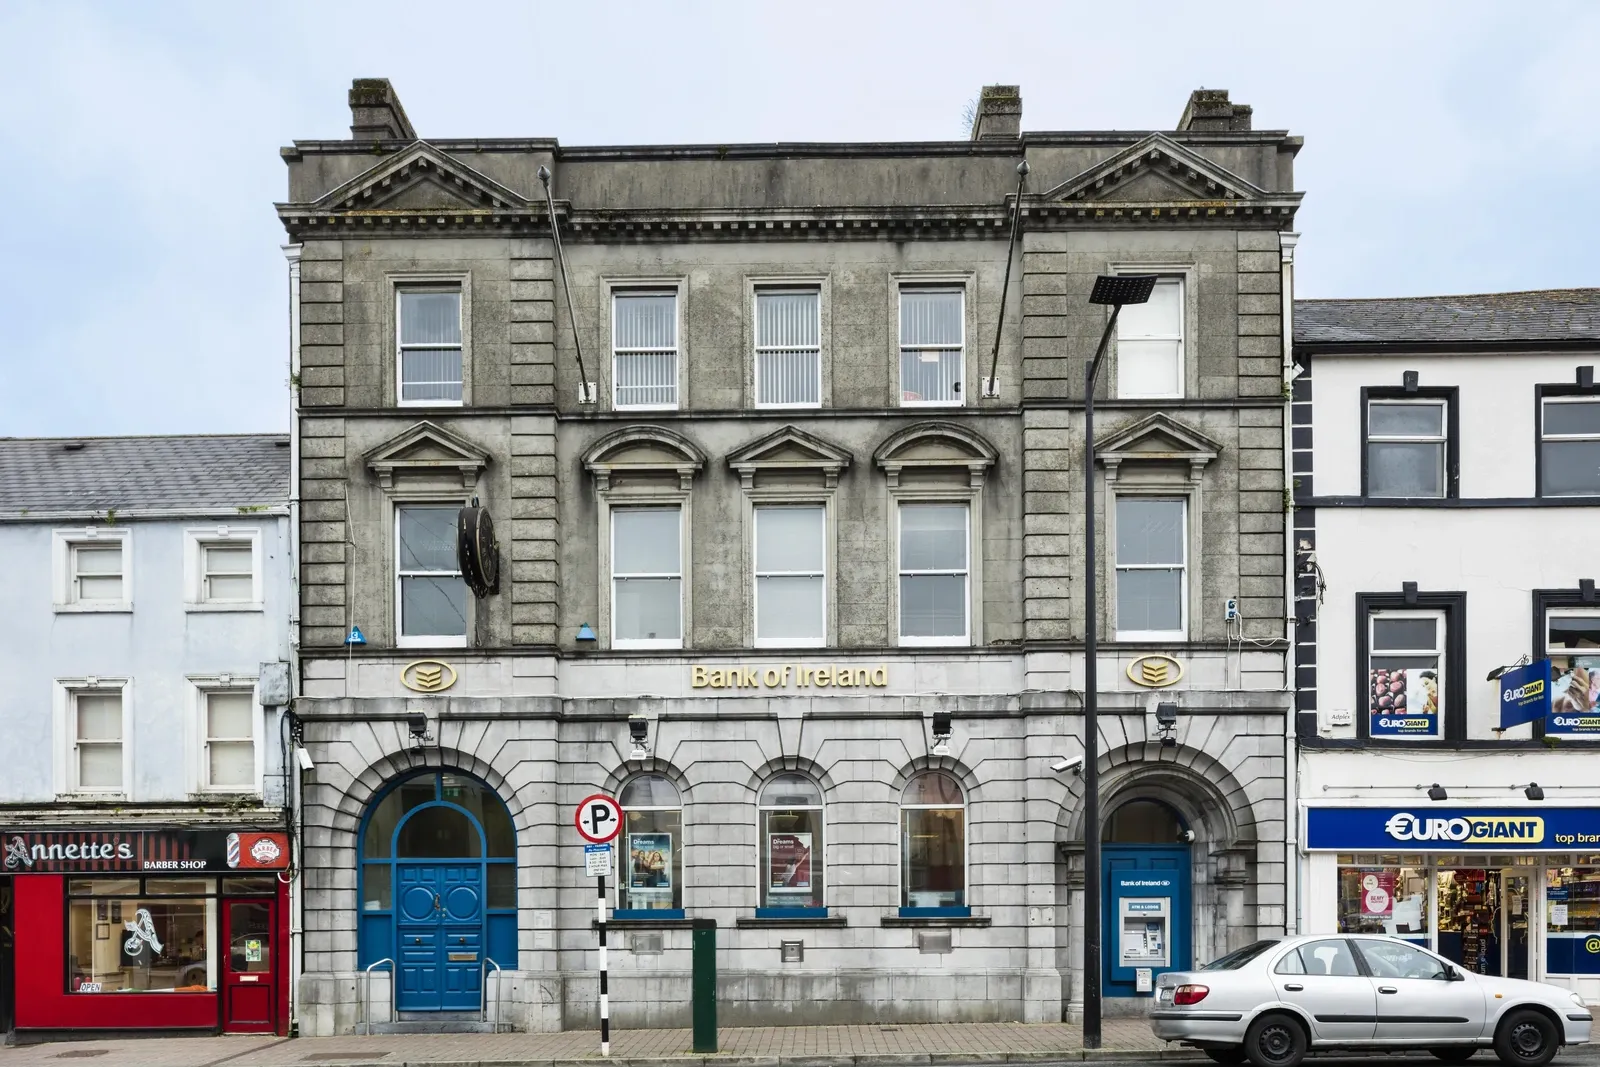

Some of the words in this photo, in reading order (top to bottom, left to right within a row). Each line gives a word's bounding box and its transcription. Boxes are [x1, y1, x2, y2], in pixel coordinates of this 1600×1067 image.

[692, 665, 759, 688] Bank
[764, 664, 792, 688] of
[796, 664, 888, 688] Ireland
[591, 804, 610, 834] P
[1555, 833, 1575, 844] top
[144, 861, 178, 869] BARBER
[181, 861, 207, 869] SHOP
[81, 983, 100, 992] OPEN
